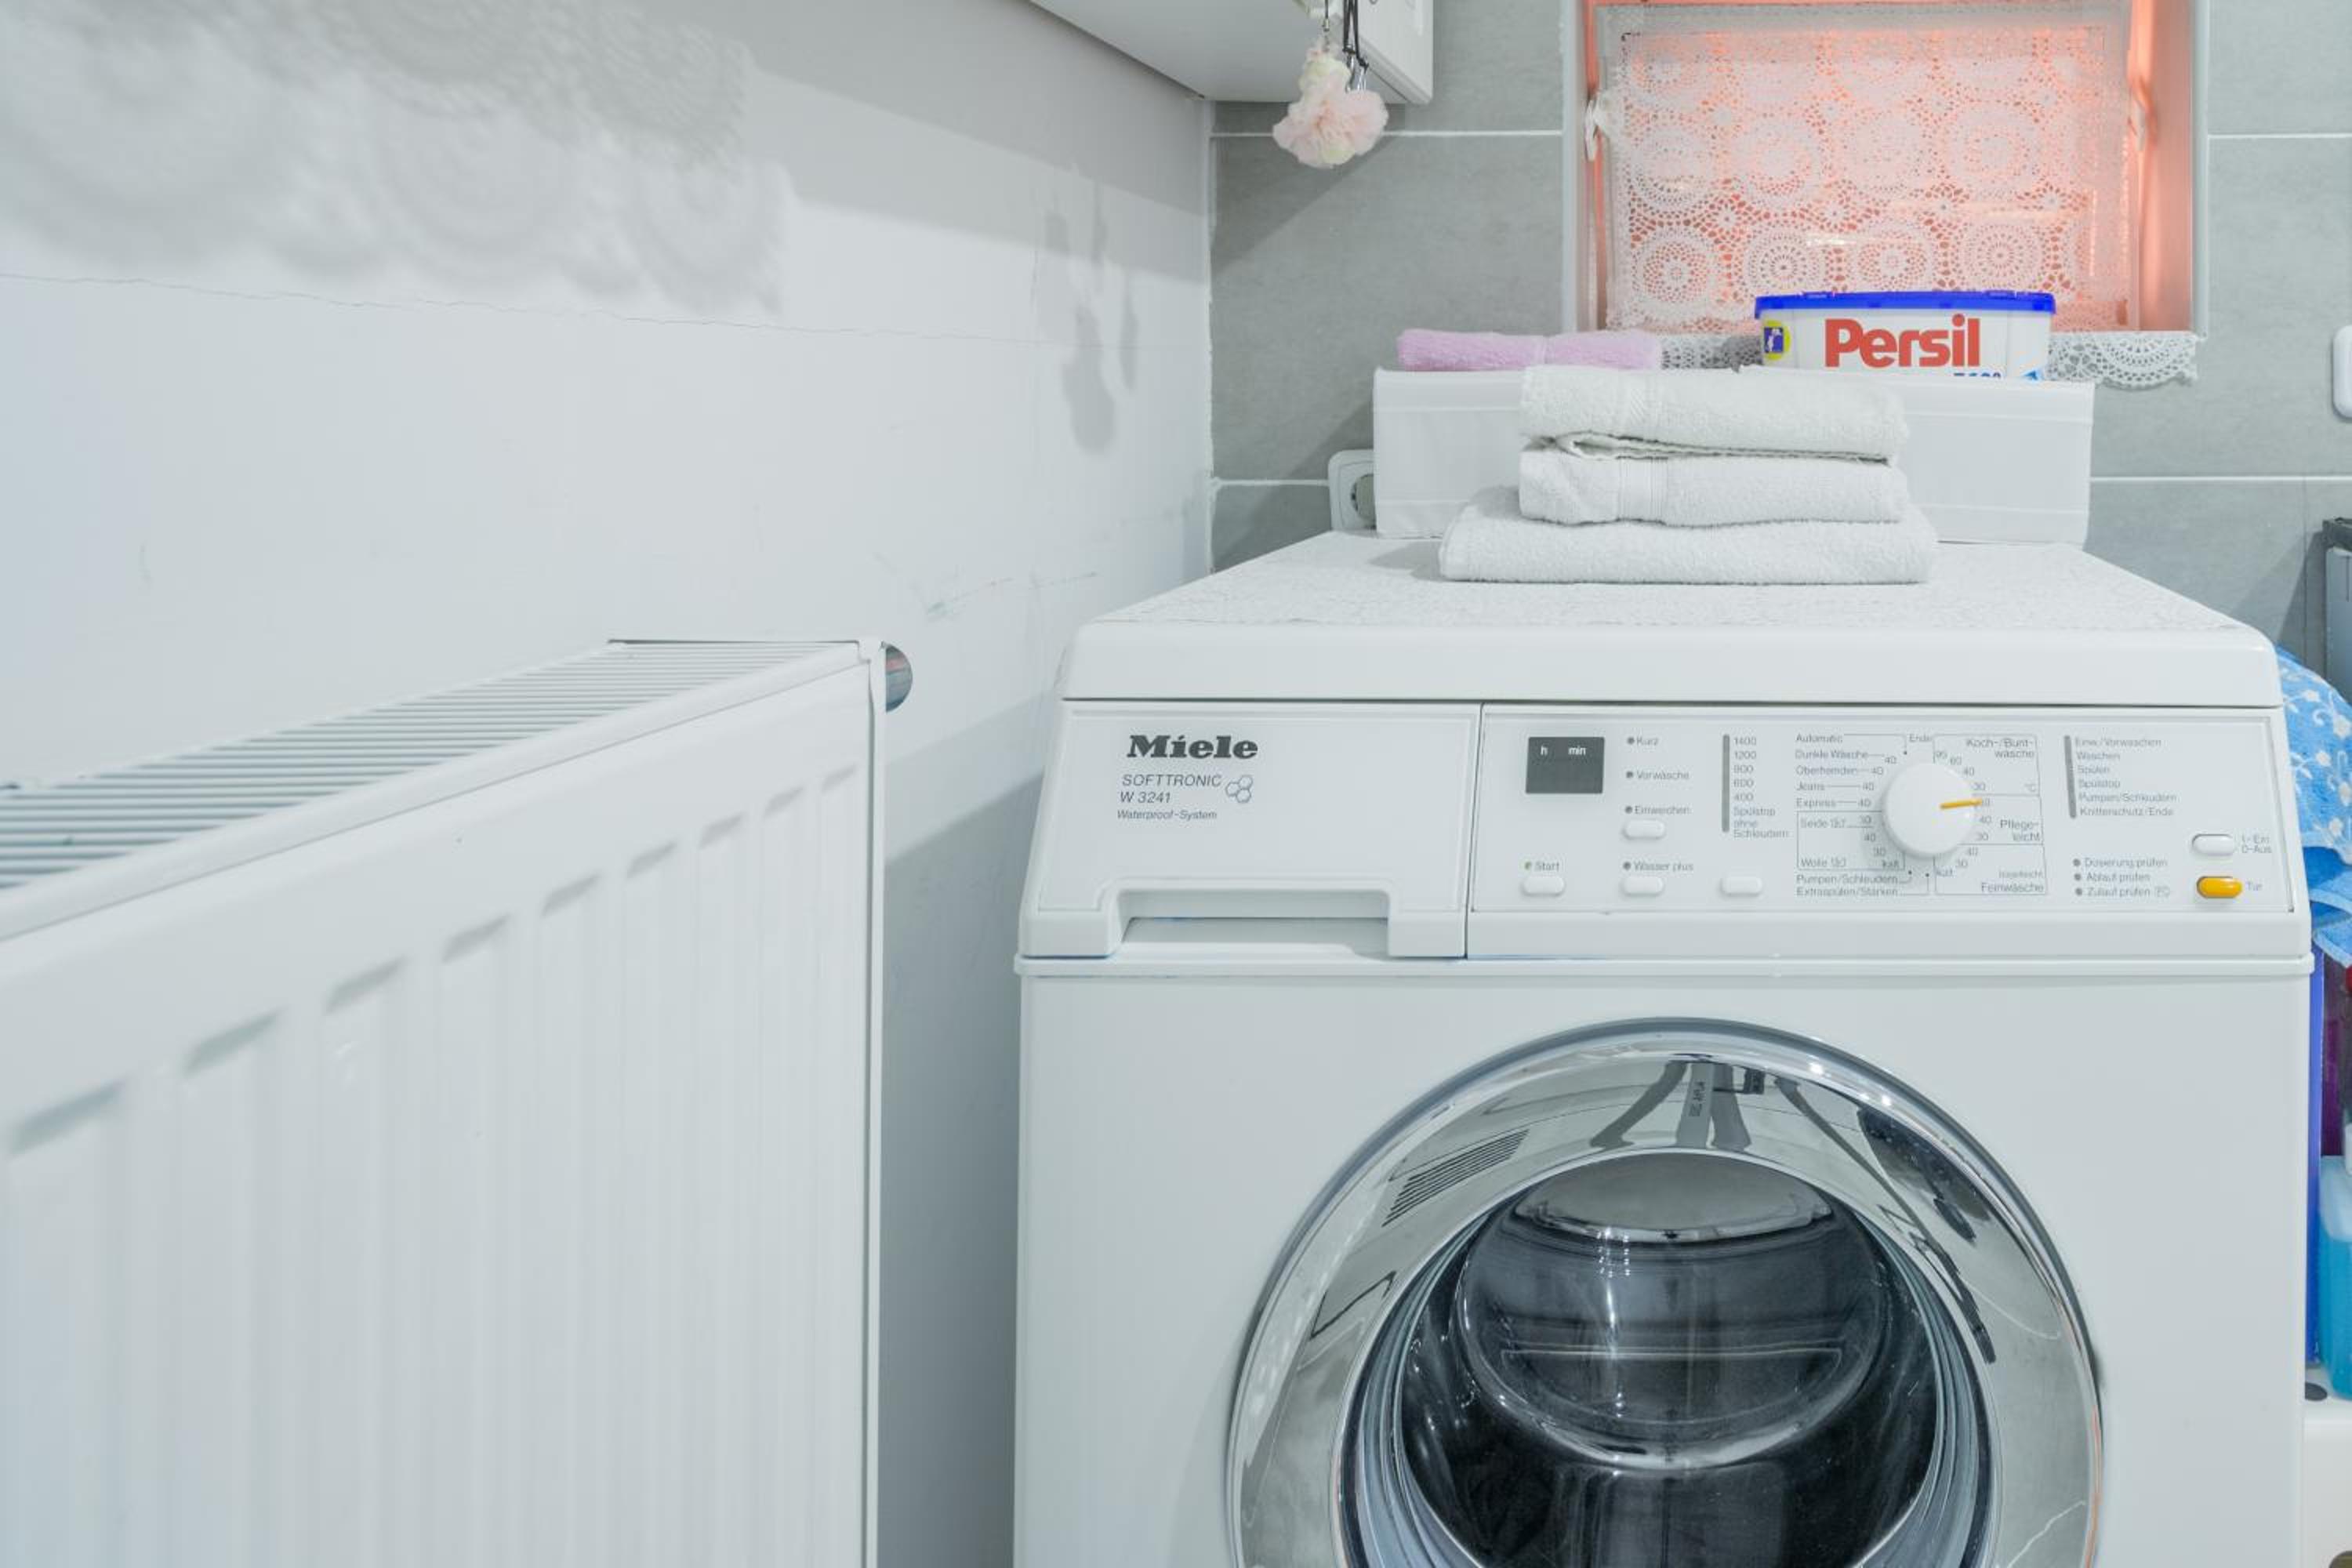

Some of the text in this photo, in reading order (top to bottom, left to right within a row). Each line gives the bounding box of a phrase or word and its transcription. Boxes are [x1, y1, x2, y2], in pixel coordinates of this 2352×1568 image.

[1824, 314, 1980, 368] Persil
[1127, 734, 1258, 759] Miele
[1636, 736, 1659, 746] Kurz
[1733, 736, 1757, 746] 1400
[1540, 745, 1587, 756] h min
[1733, 750, 1757, 760] 1200
[1122, 774, 1222, 787] SOFTTRONIC
[1120, 791, 1171, 804] W 3241
[1733, 793, 1754, 801] 400
[1117, 809, 1218, 821] Waterproof-System
[1534, 861, 1560, 872] Start
[1634, 861, 1694, 873] Wasser plus
